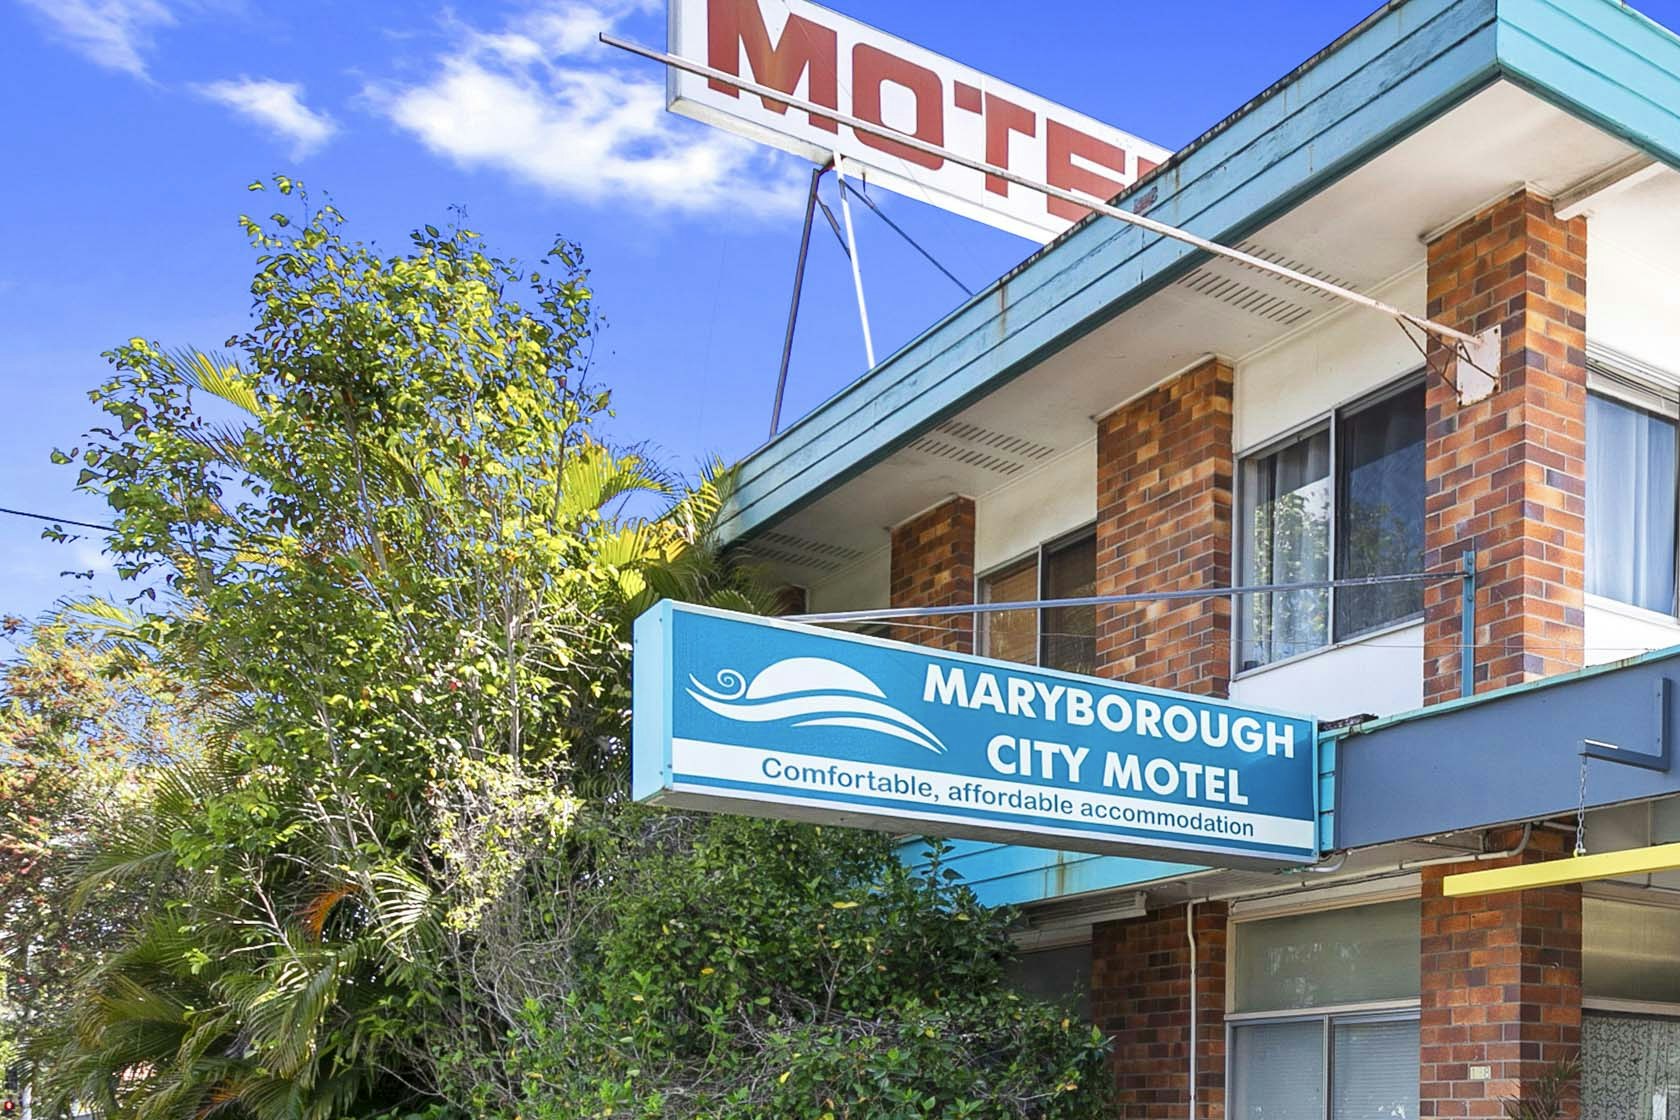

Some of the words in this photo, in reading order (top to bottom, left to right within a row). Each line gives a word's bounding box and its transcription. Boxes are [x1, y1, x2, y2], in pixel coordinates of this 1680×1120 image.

[707, 0, 1163, 223] MOTE
[923, 663, 1295, 759] MARYBOROUGH
[761, 757, 939, 803] Comfortable,
[948, 782, 1074, 815] affordable
[1080, 802, 1254, 837] accommodation
[986, 734, 1090, 783] CITY
[1103, 751, 1249, 806] MOTEL
